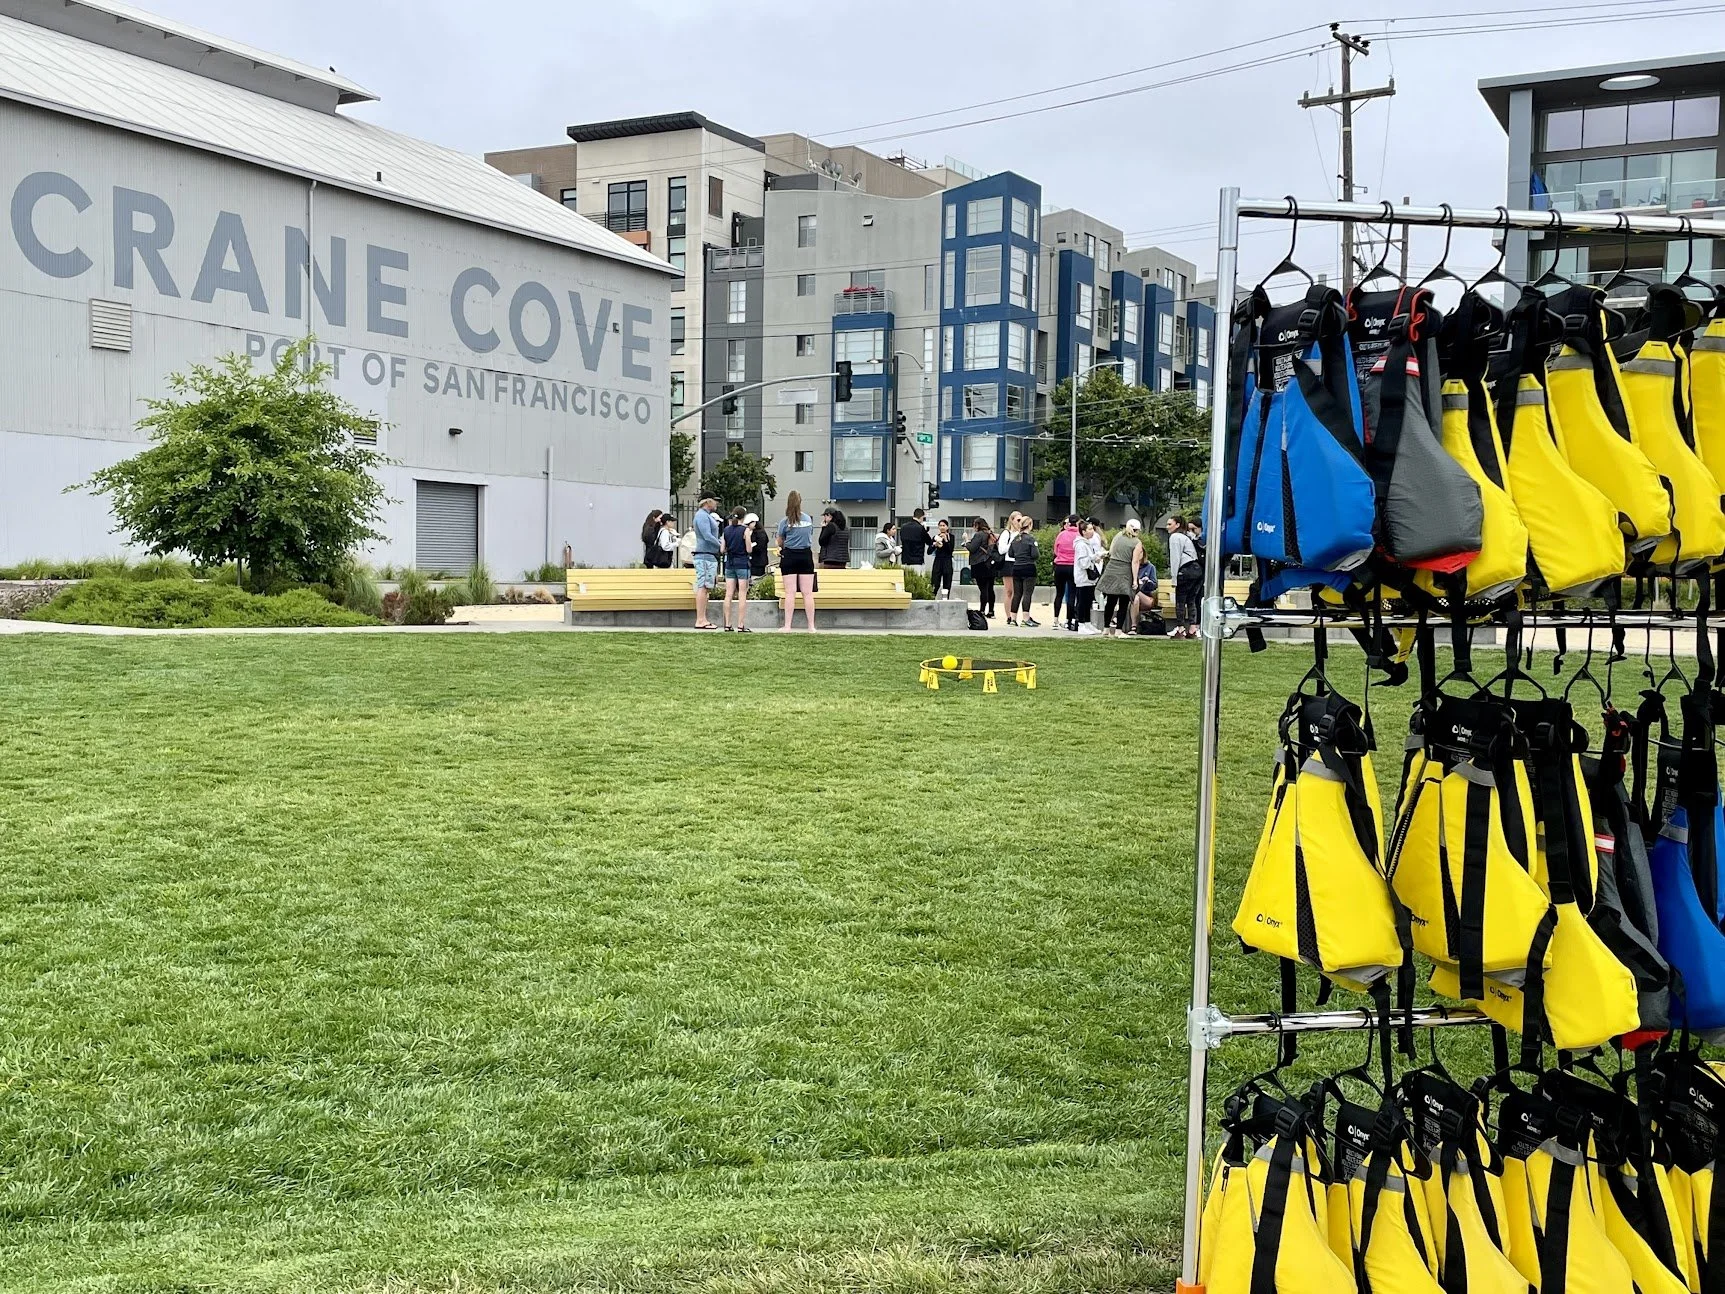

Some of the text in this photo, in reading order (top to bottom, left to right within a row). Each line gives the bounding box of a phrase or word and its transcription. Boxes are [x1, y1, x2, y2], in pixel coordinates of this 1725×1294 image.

[10, 171, 653, 382] CRANE COVE
[362, 352, 407, 388] OF
[423, 361, 485, 401] SAN
[494, 373, 651, 425] FRANCISCO
[1267, 916, 1280, 928] Onyx
[1356, 1128, 1370, 1142] Onyx
